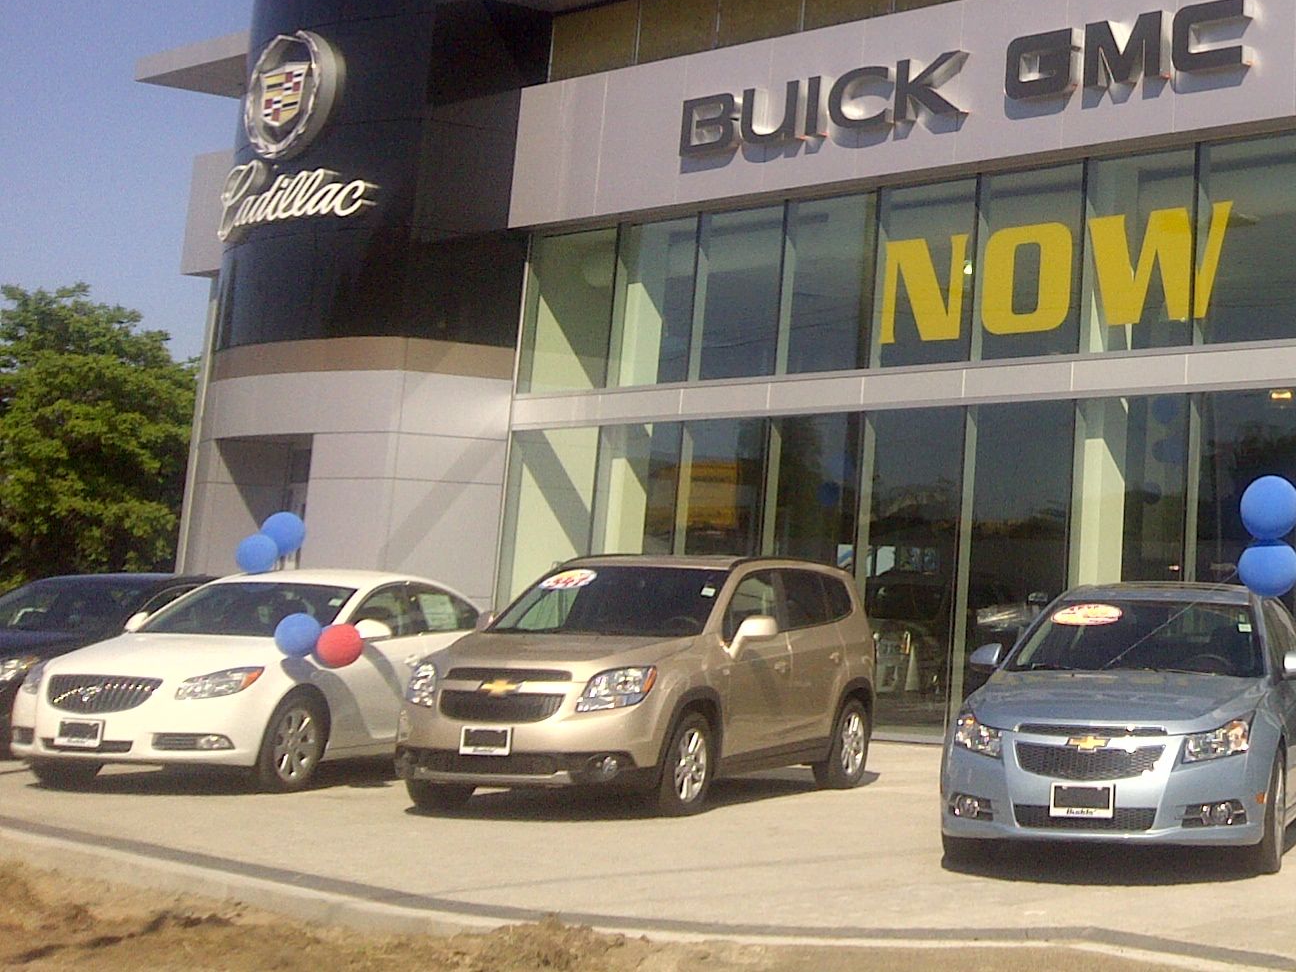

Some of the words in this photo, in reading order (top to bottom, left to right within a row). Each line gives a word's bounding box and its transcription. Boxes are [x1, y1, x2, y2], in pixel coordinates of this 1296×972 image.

[679, 50, 970, 158] BUICK
[217, 159, 373, 243] Cadillac
[880, 200, 1234, 345] NOW
